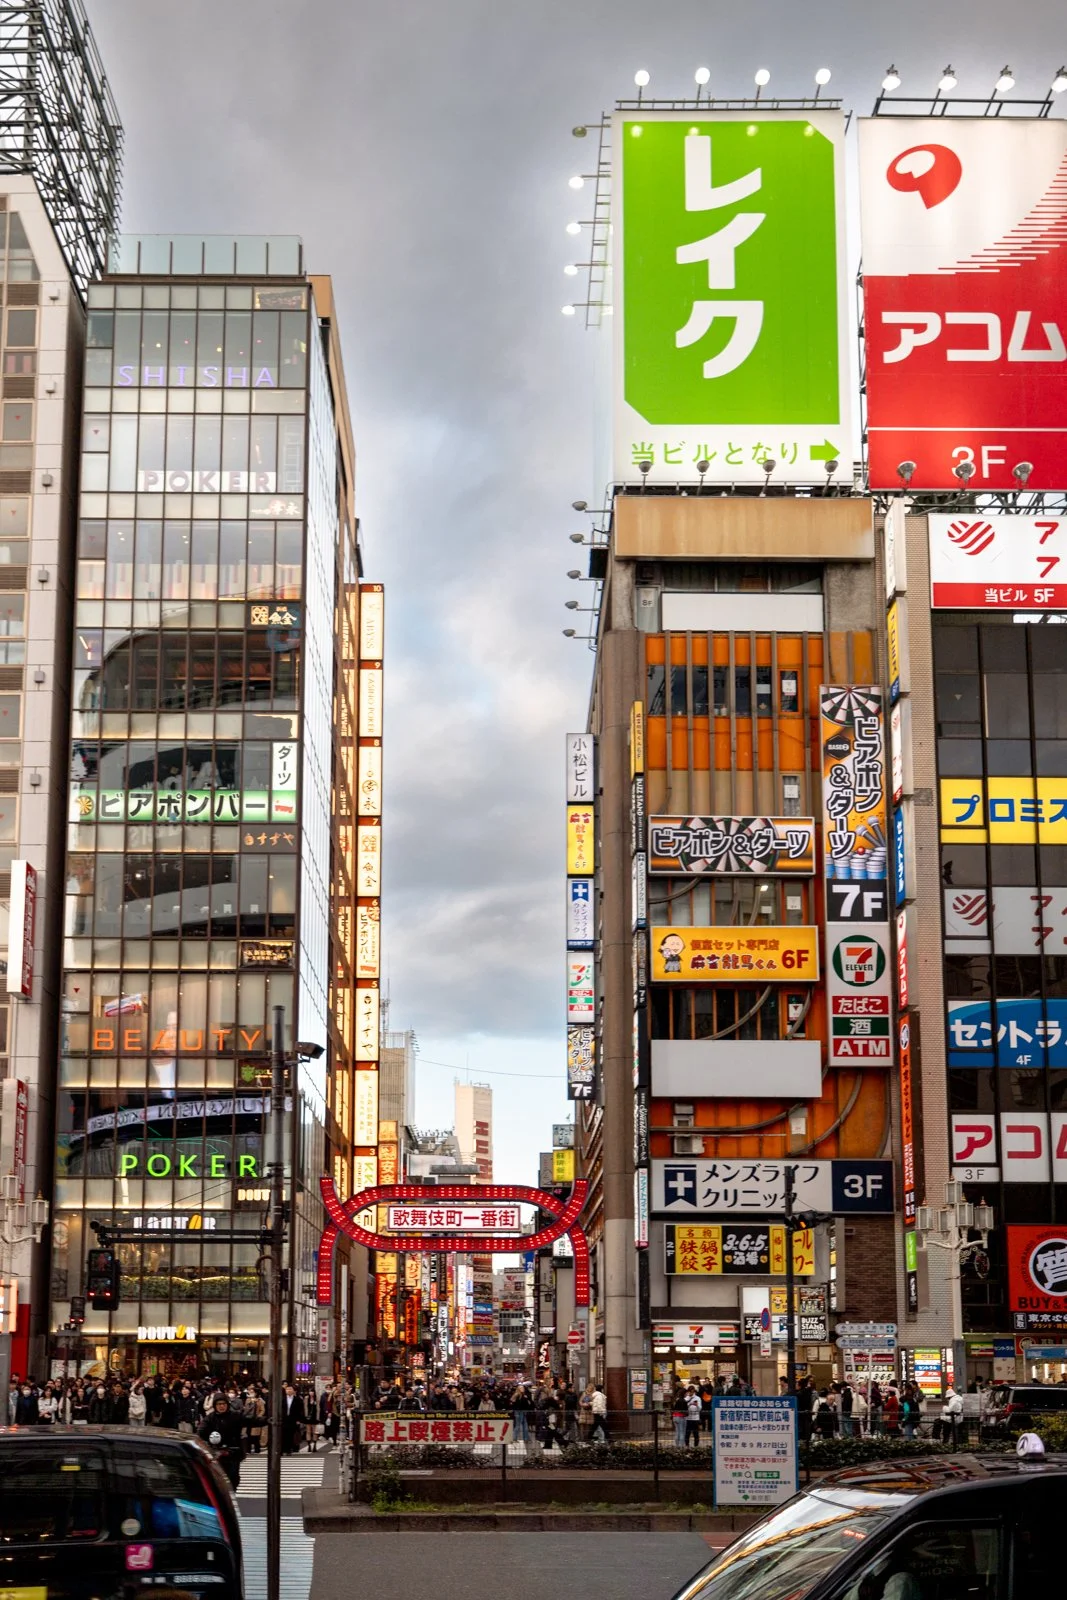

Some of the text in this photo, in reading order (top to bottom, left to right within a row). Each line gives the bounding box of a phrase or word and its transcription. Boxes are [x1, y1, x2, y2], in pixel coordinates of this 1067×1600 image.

[675, 135, 766, 379] レイク
[881, 310, 1067, 363] アコム
[118, 365, 275, 387] SHISHA
[631, 441, 799, 465] 当ビルとなり
[951, 445, 1007, 478] 3F
[144, 471, 273, 492] POKER
[984, 587, 1055, 603] 当ビル 5F
[374, 661, 381, 669] 9
[373, 739, 380, 747] 8
[277, 744, 294, 786] ダーツ
[573, 737, 588, 797] 小松ビル
[853, 716, 883, 813] ビアポン
[100, 793, 266, 819] ビアポンバー
[951, 793, 1067, 823] プロミス
[372, 818, 379, 826] 7
[651, 828, 809, 859] ビアポン&ダーツ
[371, 898, 378, 906] 6
[831, 883, 883, 918] 7F
[1030, 895, 1067, 917] ア
[1031, 926, 1067, 947] フ
[781, 949, 810, 969] 6F
[371, 980, 378, 988] 5
[837, 997, 883, 1014] たばこ
[849, 1018, 872, 1035] 酒
[950, 1018, 1067, 1049] セントラ
[93, 1028, 262, 1051] BEAUTY
[836, 1040, 887, 1056] ATM
[369, 1062, 377, 1070] 4
[1015, 1054, 1033, 1065] 4F
[571, 1083, 592, 1097] 7F
[369, 1148, 376, 1156] 3
[954, 1123, 1067, 1160] アコ
[120, 1153, 259, 1178] POKER
[964, 1168, 985, 1180] 3F
[843, 1174, 883, 1199] 3F
[392, 1208, 516, 1228] 歌舞伎町一番街
[666, 1241, 675, 1257] 2F
[793, 1229, 813, 1250] ール
